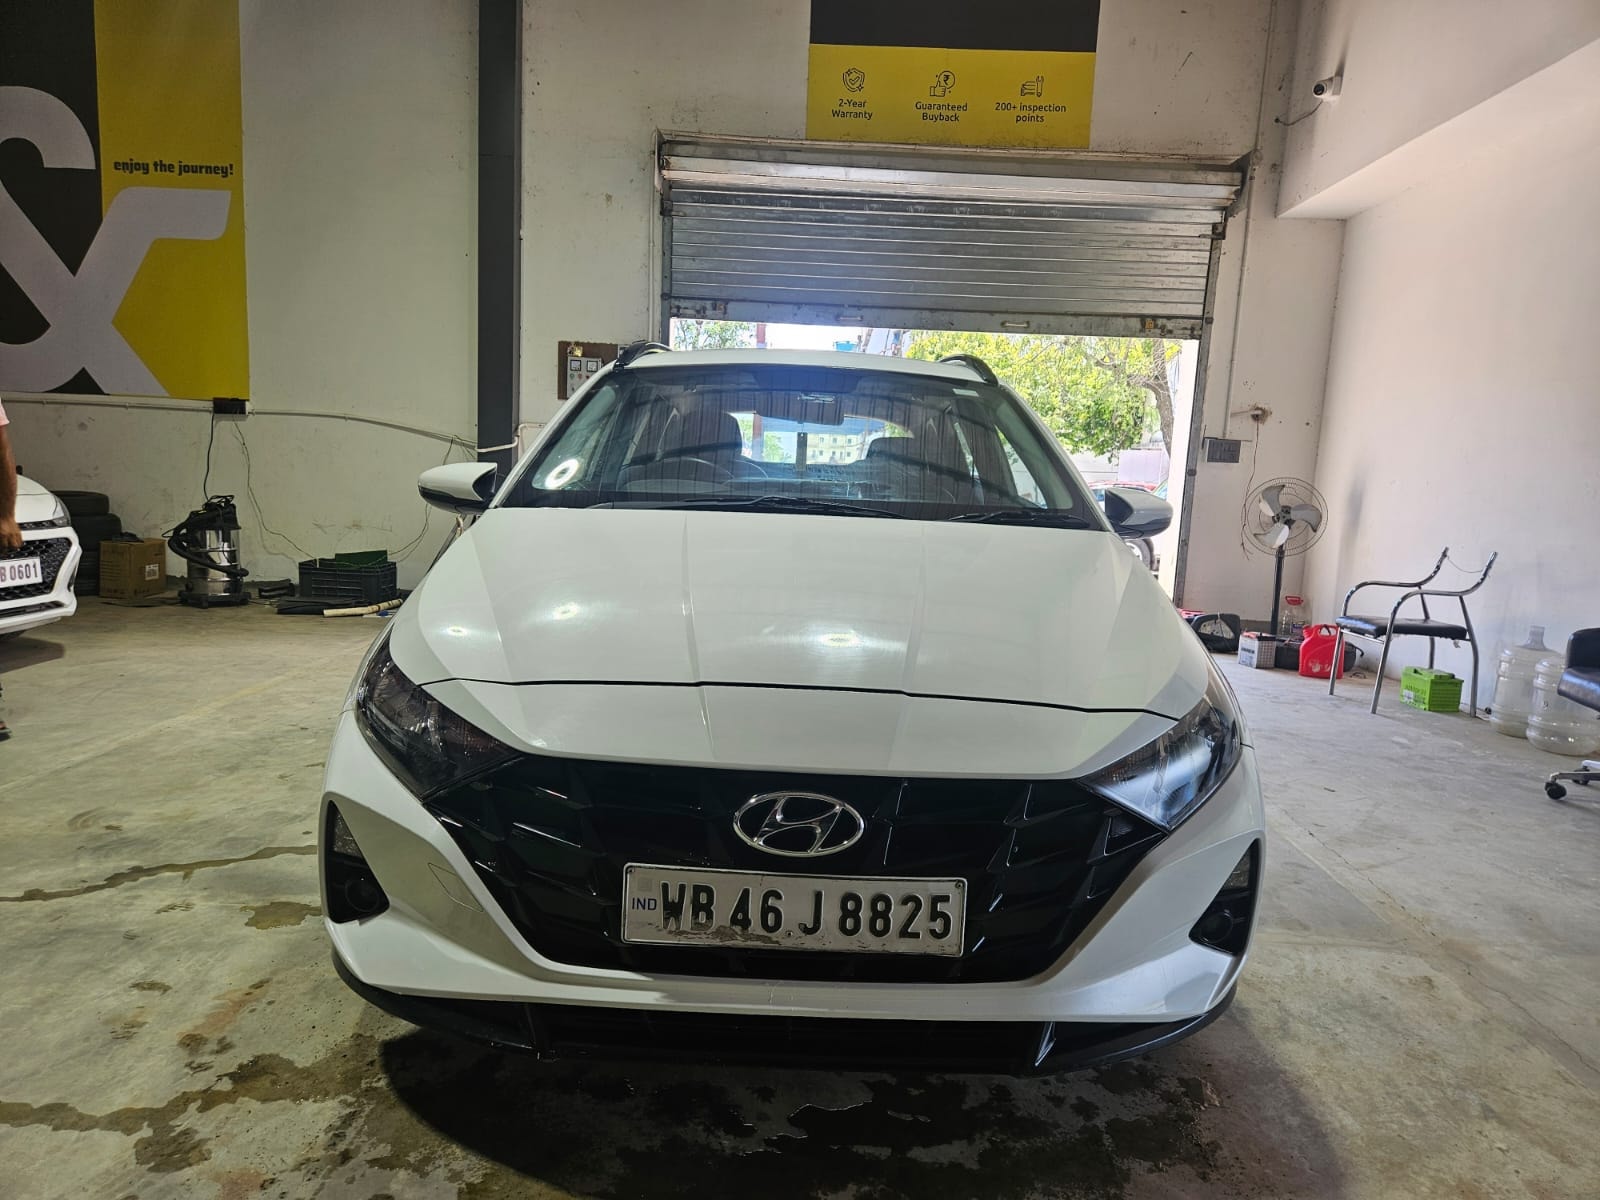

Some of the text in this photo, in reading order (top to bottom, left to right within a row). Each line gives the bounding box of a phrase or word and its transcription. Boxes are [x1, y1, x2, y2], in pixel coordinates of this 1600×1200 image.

[838, 99, 867, 108] 2-Year
[915, 101, 968, 112] Guaranteed
[995, 102, 1067, 113] 200+ inspection
[831, 109, 873, 120] Warranty
[922, 112, 960, 122] Buyback
[1015, 114, 1045, 123] points
[113, 158, 234, 178] enjoy the journey!
[10, 561, 38, 581] 0601
[631, 897, 657, 911] IND
[729, 887, 784, 934] 46
[800, 890, 824, 936] J
[838, 892, 953, 940] 8825
